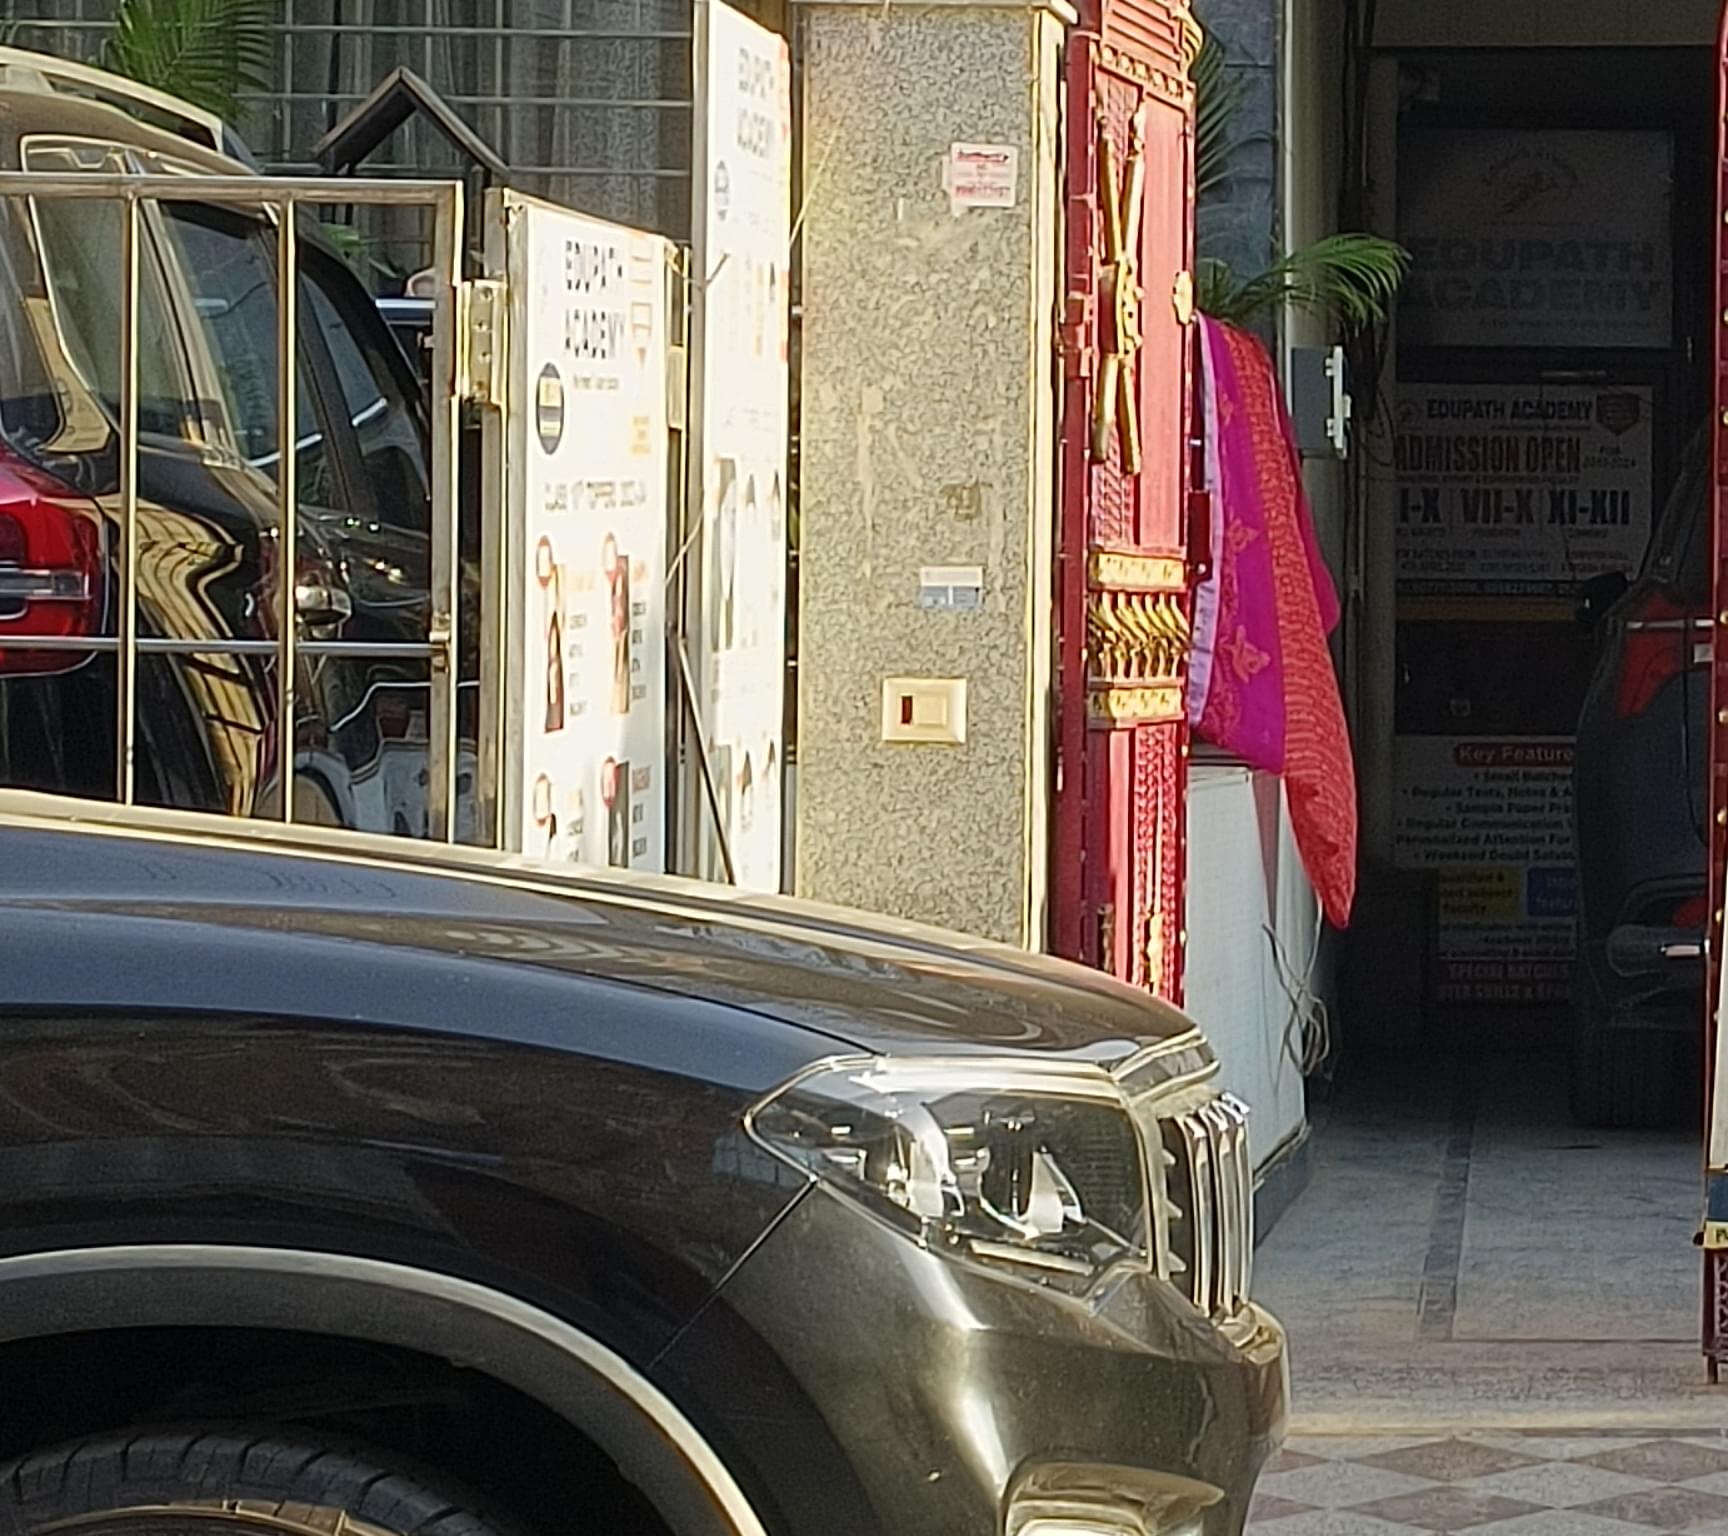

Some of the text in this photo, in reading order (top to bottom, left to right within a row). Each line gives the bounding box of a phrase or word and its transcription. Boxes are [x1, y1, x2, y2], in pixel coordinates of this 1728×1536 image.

[1426, 398, 1594, 421] EDUPATH ACADEMY
[1525, 435, 1581, 474] OPEN
[1460, 487, 1535, 525] VII-X
[1547, 488, 1631, 526] XI-XII
[1459, 745, 1496, 764] Key
